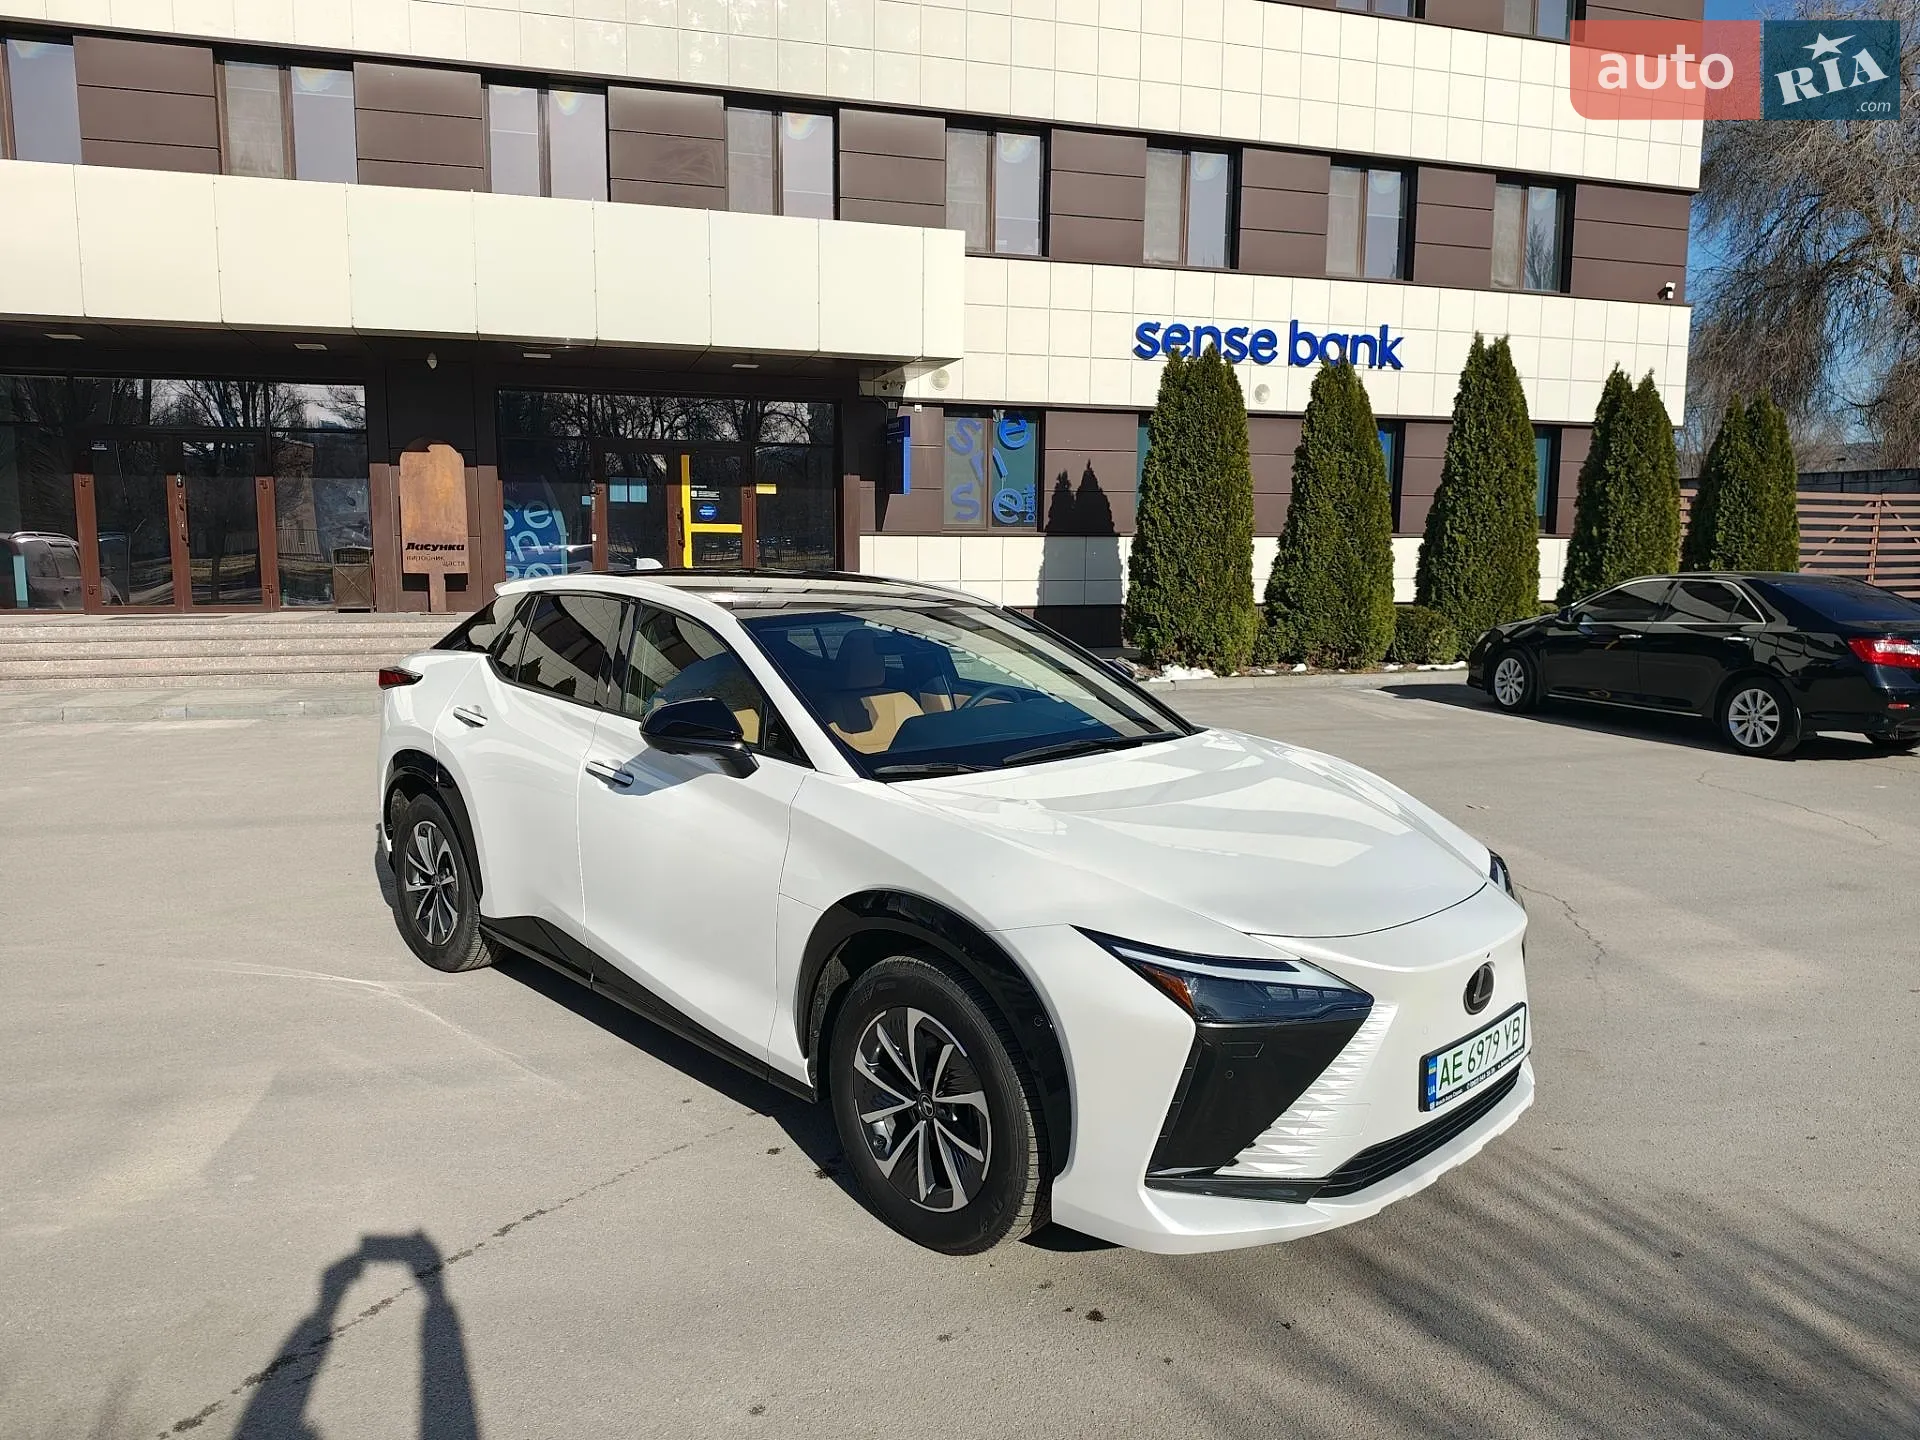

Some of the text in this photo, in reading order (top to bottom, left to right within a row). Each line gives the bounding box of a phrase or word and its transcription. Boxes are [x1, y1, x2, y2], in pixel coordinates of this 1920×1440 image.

[1133, 319, 1404, 370] sense bank
[405, 542, 465, 551] Ласунка
[1438, 1050, 1463, 1091] AE
[1467, 1030, 1500, 1074] 6979
[1504, 1016, 1521, 1051] YB
